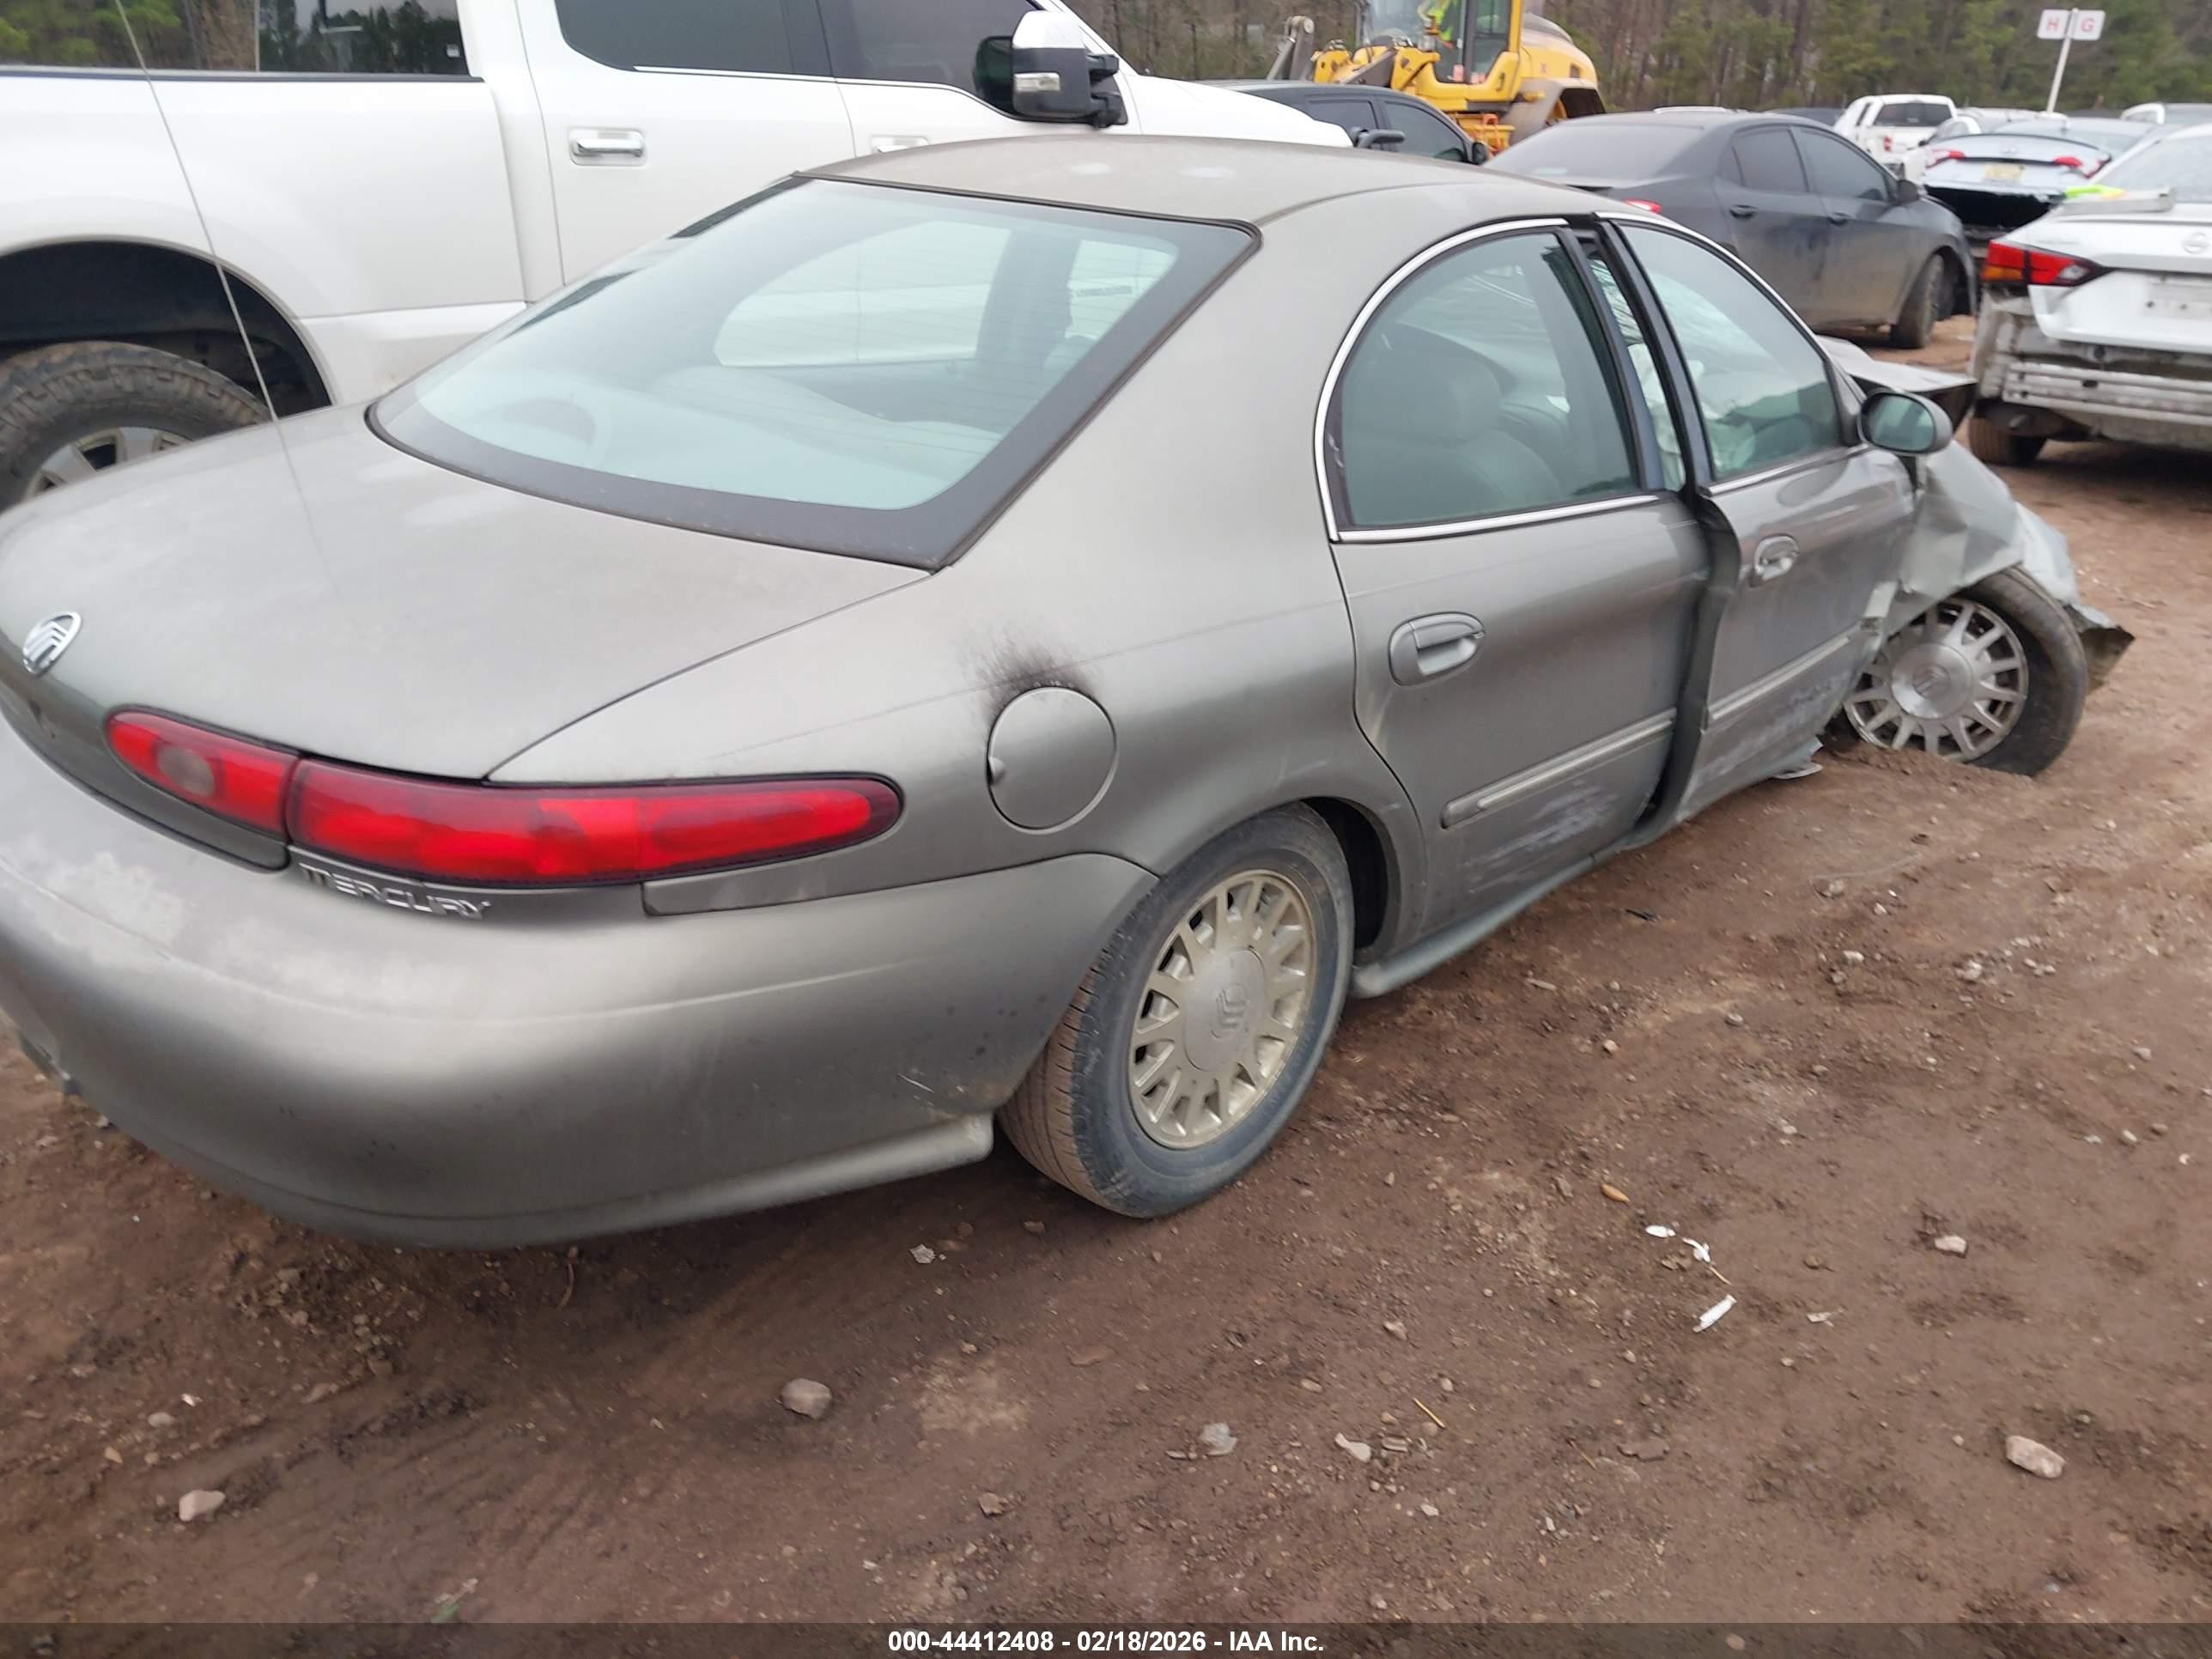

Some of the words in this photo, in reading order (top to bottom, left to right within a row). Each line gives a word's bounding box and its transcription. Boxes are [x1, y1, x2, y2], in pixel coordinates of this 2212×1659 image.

[2046, 17, 2059, 32] H
[2080, 16, 2095, 33] G
[298, 861, 492, 920] MERCURY
